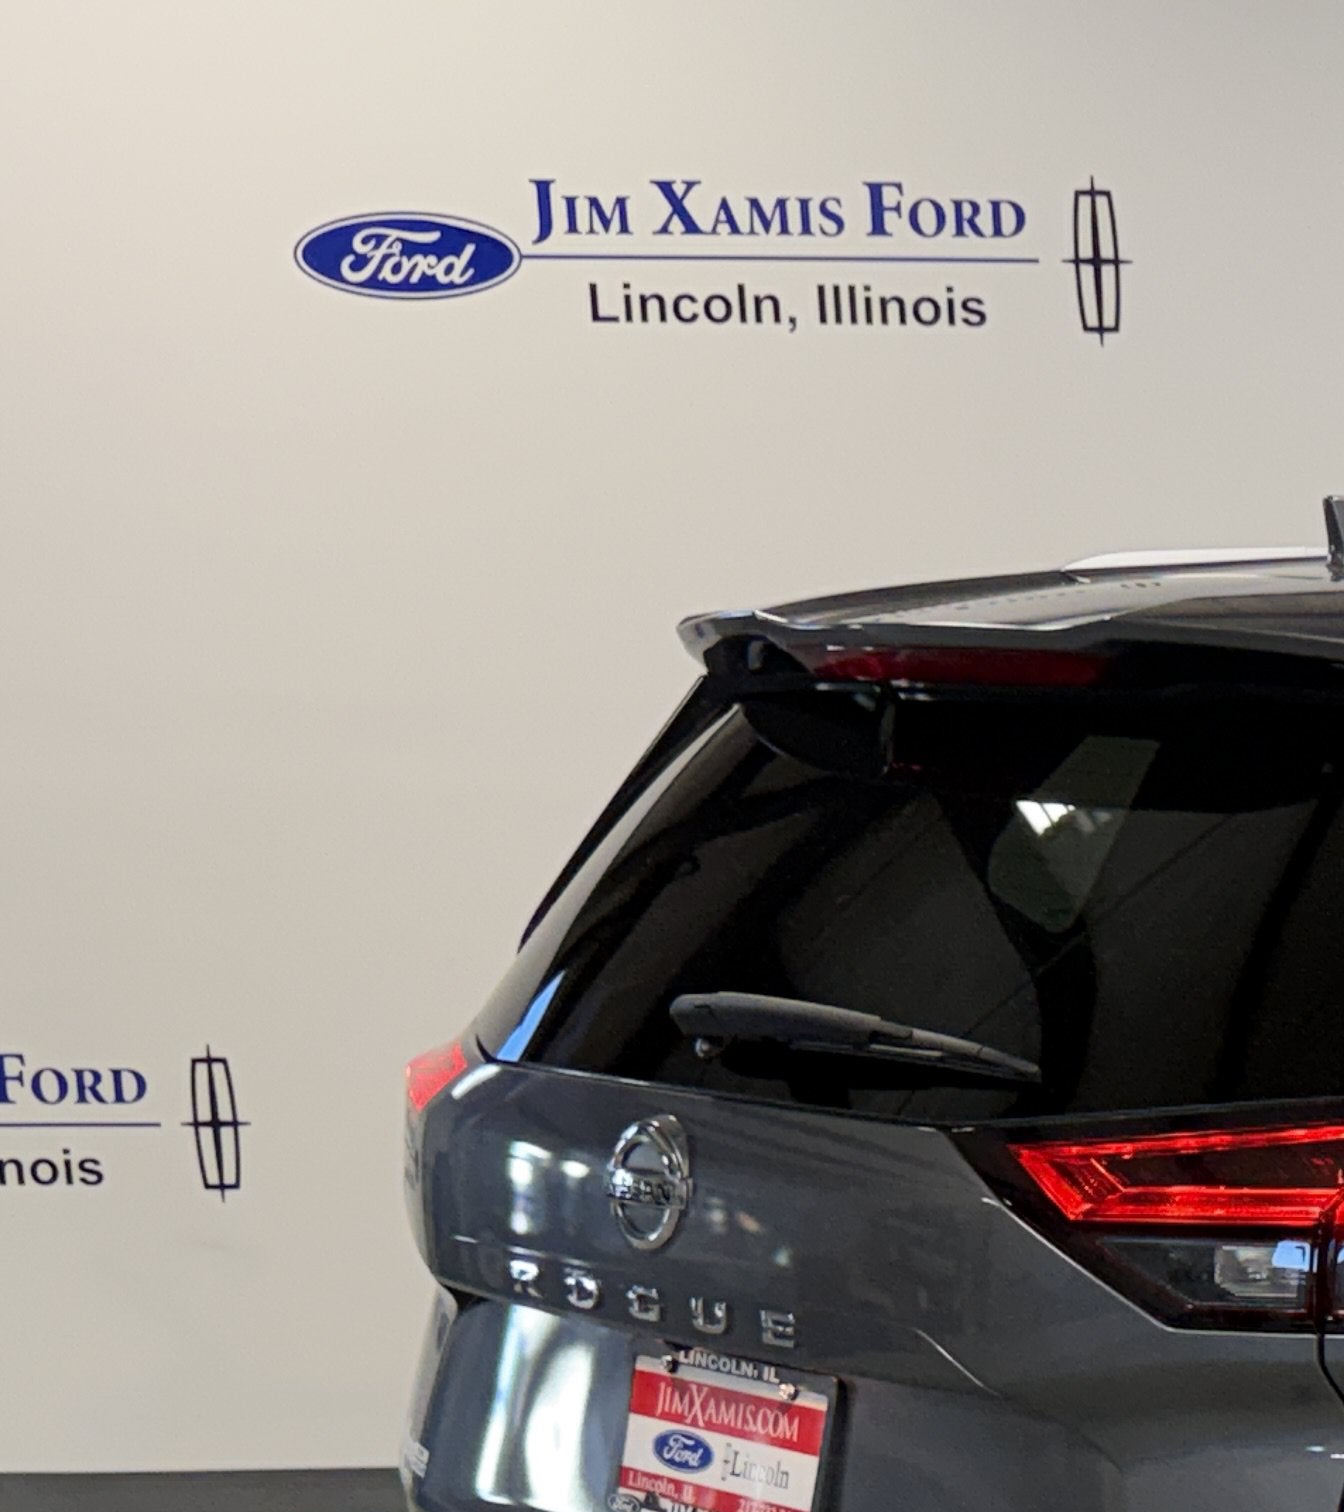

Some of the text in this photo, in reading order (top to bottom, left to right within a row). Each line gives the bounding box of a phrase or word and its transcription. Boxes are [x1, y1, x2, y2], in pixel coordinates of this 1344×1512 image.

[529, 179, 1026, 245] JIM XAMIS FORD
[340, 226, 477, 285] Ford
[589, 282, 988, 334] Lincoln, Illinois
[762, 1364, 781, 1383] IL
[663, 1434, 704, 1467] Ford
[729, 1449, 790, 1490] Lincoln
